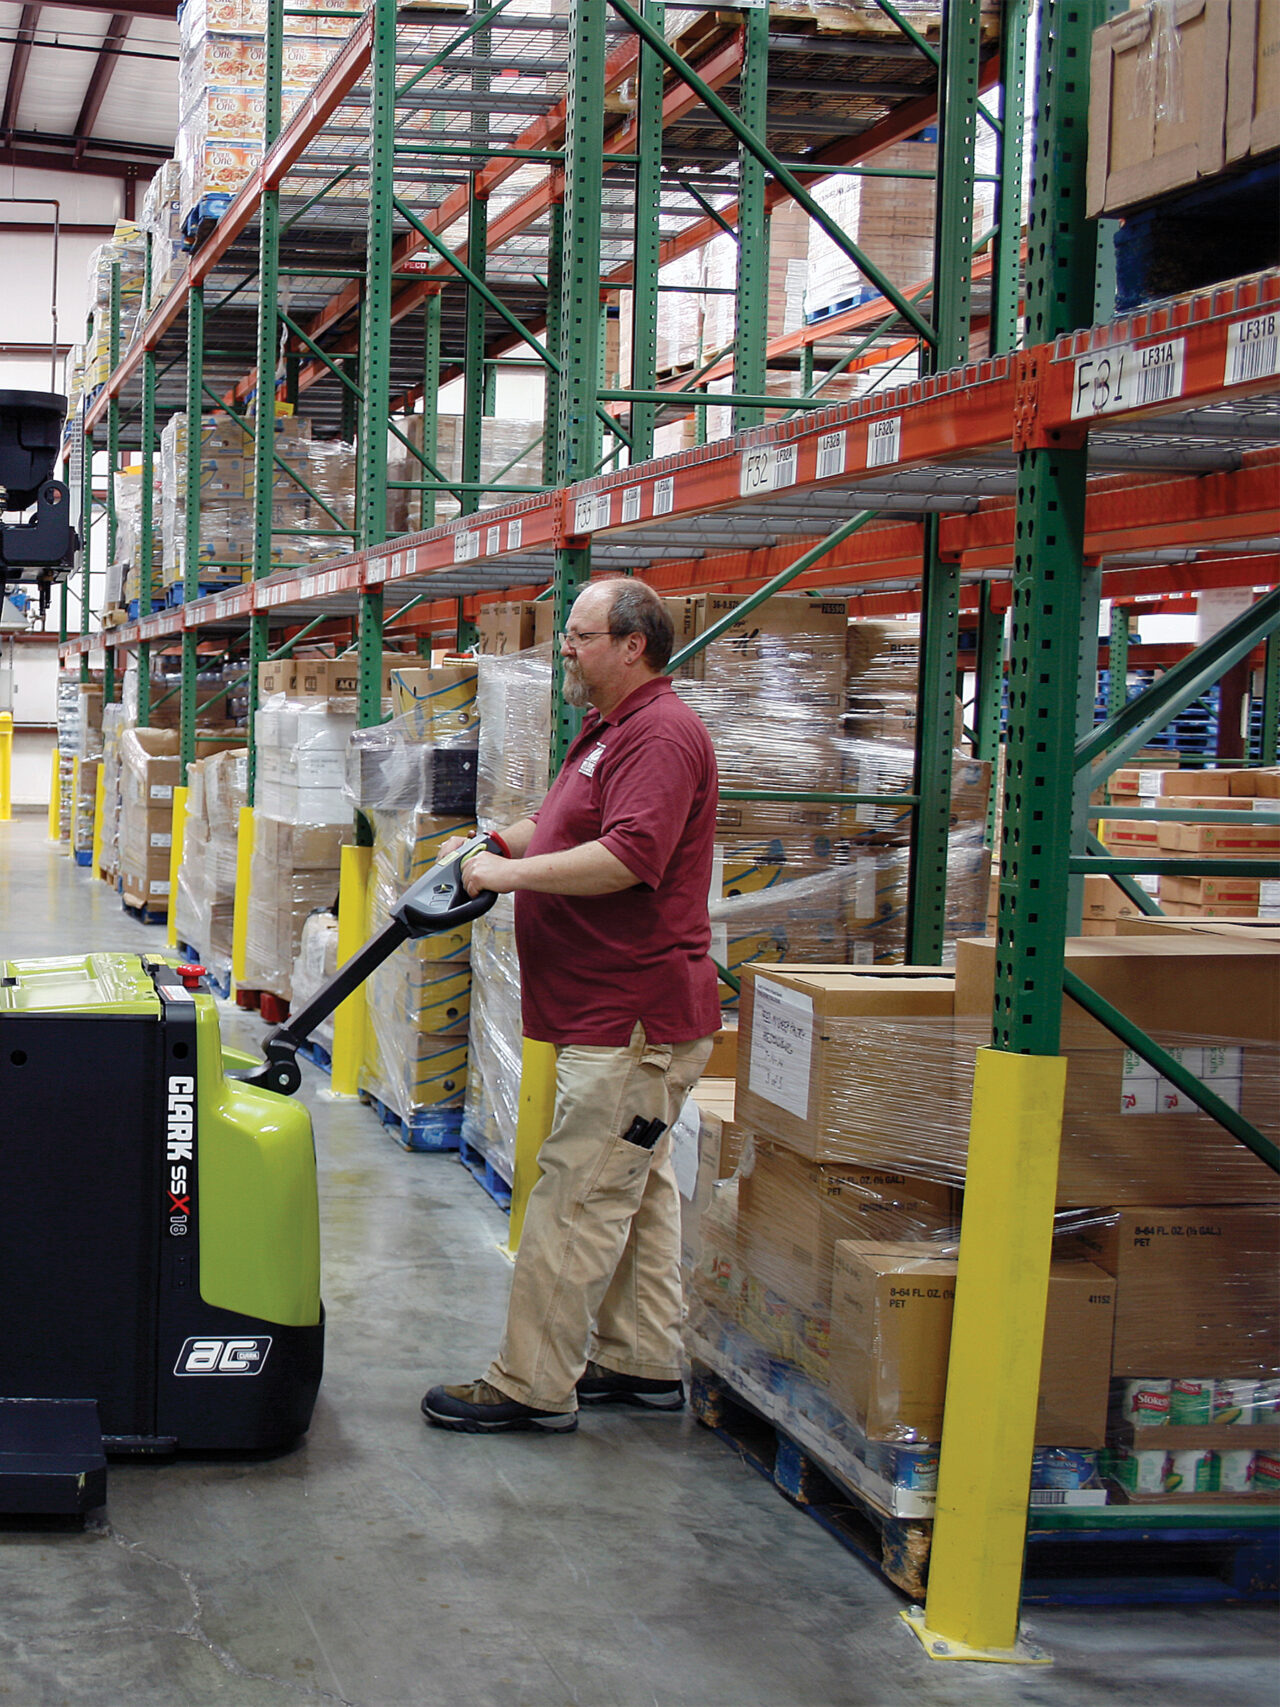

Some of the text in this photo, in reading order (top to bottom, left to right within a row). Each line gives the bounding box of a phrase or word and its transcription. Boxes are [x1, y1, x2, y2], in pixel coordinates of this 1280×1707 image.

[1238, 317, 1275, 343] LF31B
[1141, 343, 1174, 368] LF31A
[1076, 353, 1125, 414] F31
[874, 420, 895, 438] LF32C
[823, 433, 841, 450] LF32B
[745, 453, 768, 492] F32
[166, 1076, 195, 1161] CLARK
[827, 1187, 842, 1196] PET
[1133, 1238, 1151, 1247] PET
[889, 1287, 910, 1297] 8-64
[926, 1289, 941, 1298] OZ.
[889, 1300, 906, 1308] PET
